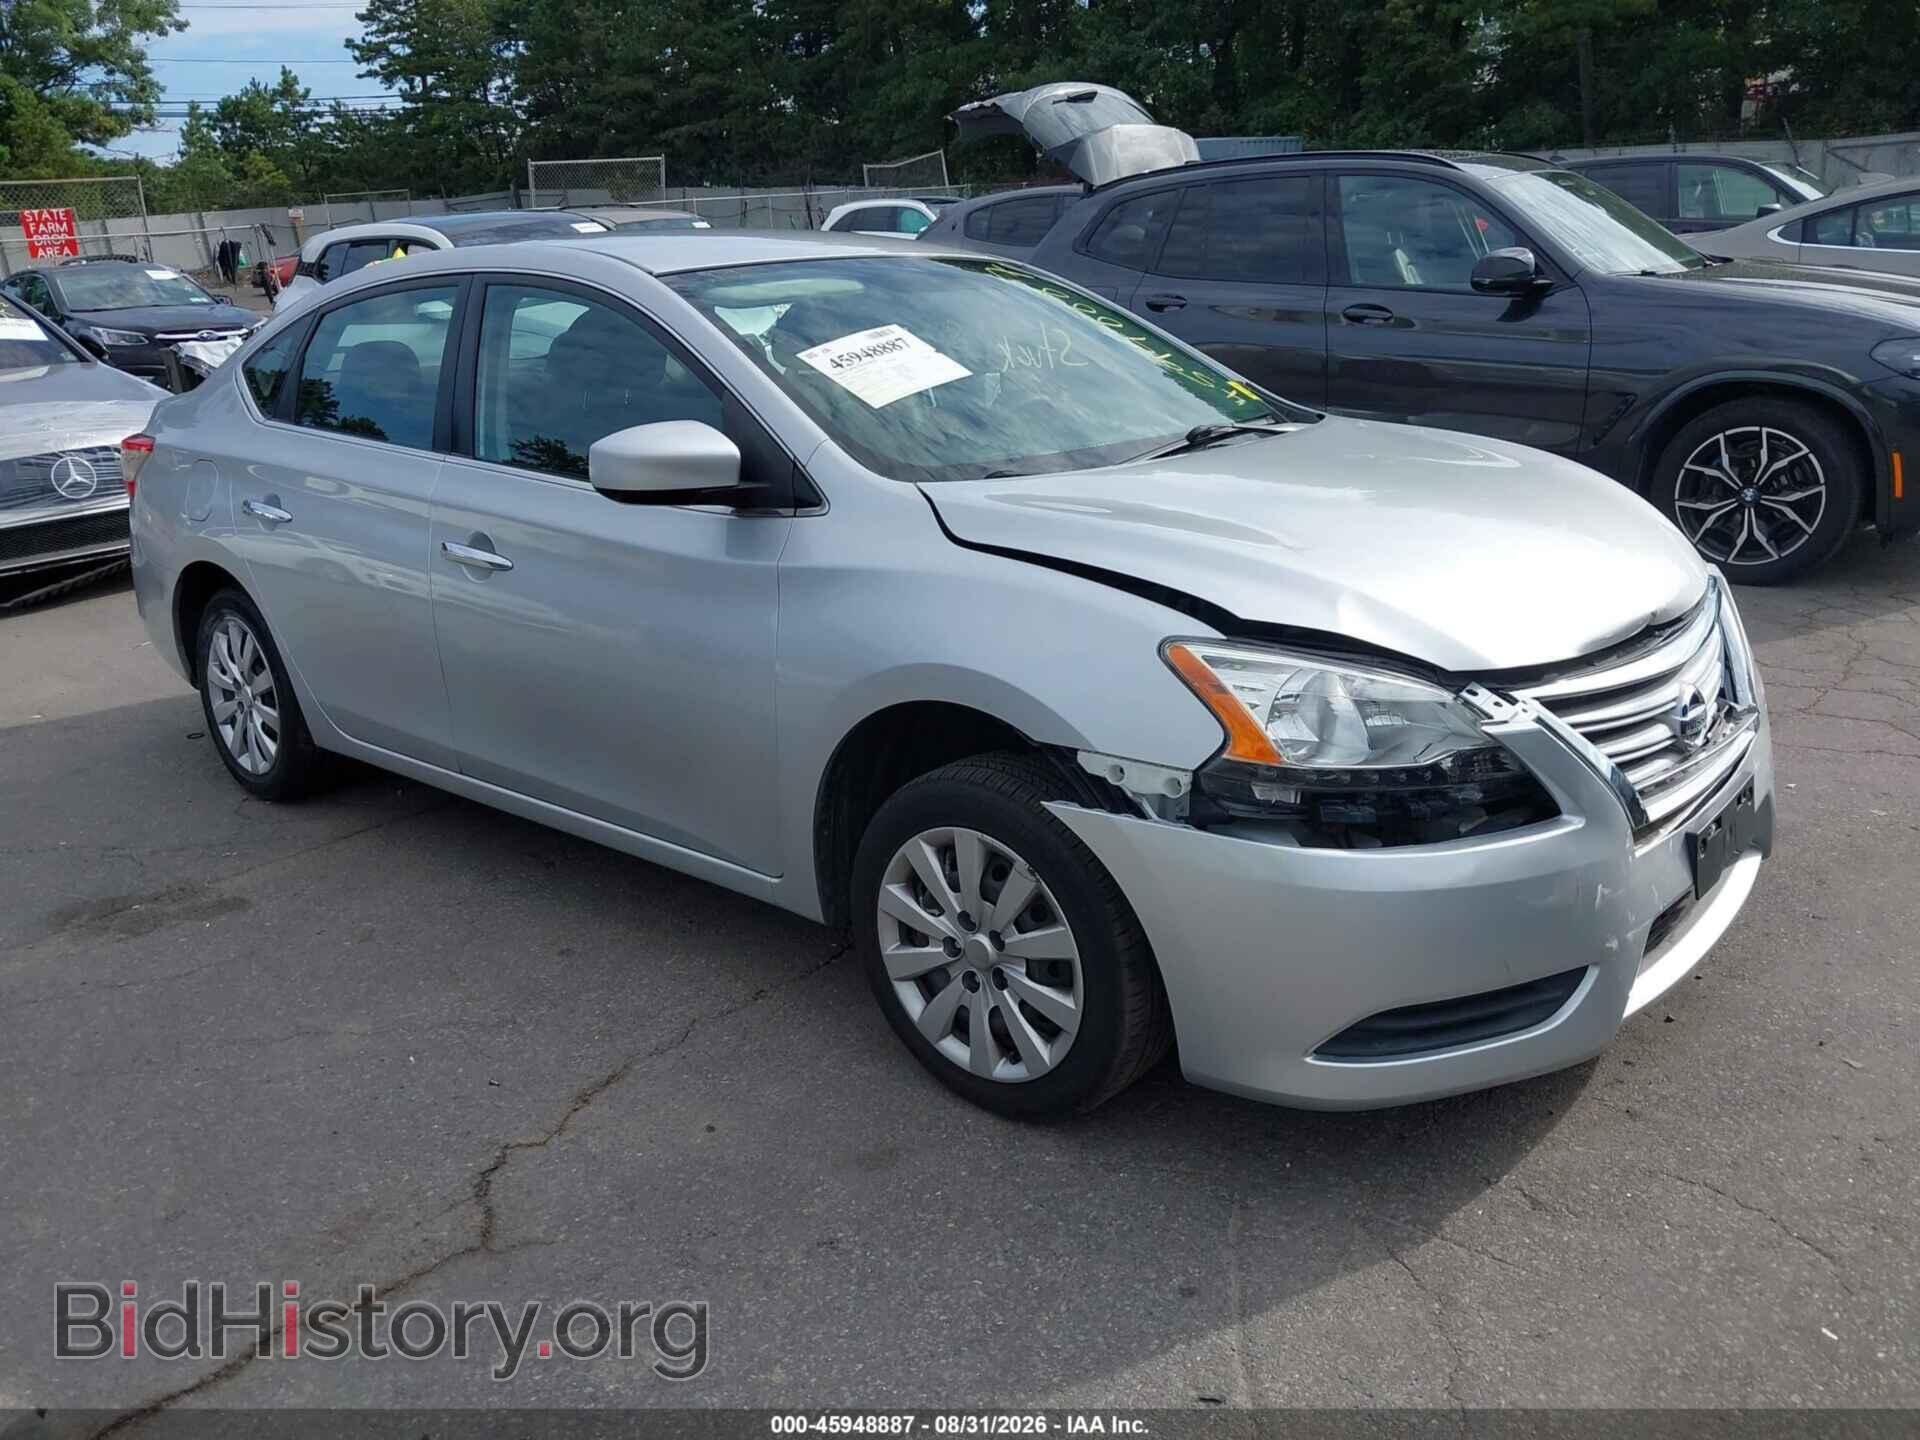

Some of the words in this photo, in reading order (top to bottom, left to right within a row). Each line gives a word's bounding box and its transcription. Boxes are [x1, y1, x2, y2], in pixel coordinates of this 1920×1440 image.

[23, 208, 67, 222] STATE
[29, 221, 69, 234] FARM
[33, 233, 68, 246] DROP
[38, 246, 73, 258] AREA
[829, 337, 911, 369] 45948887
